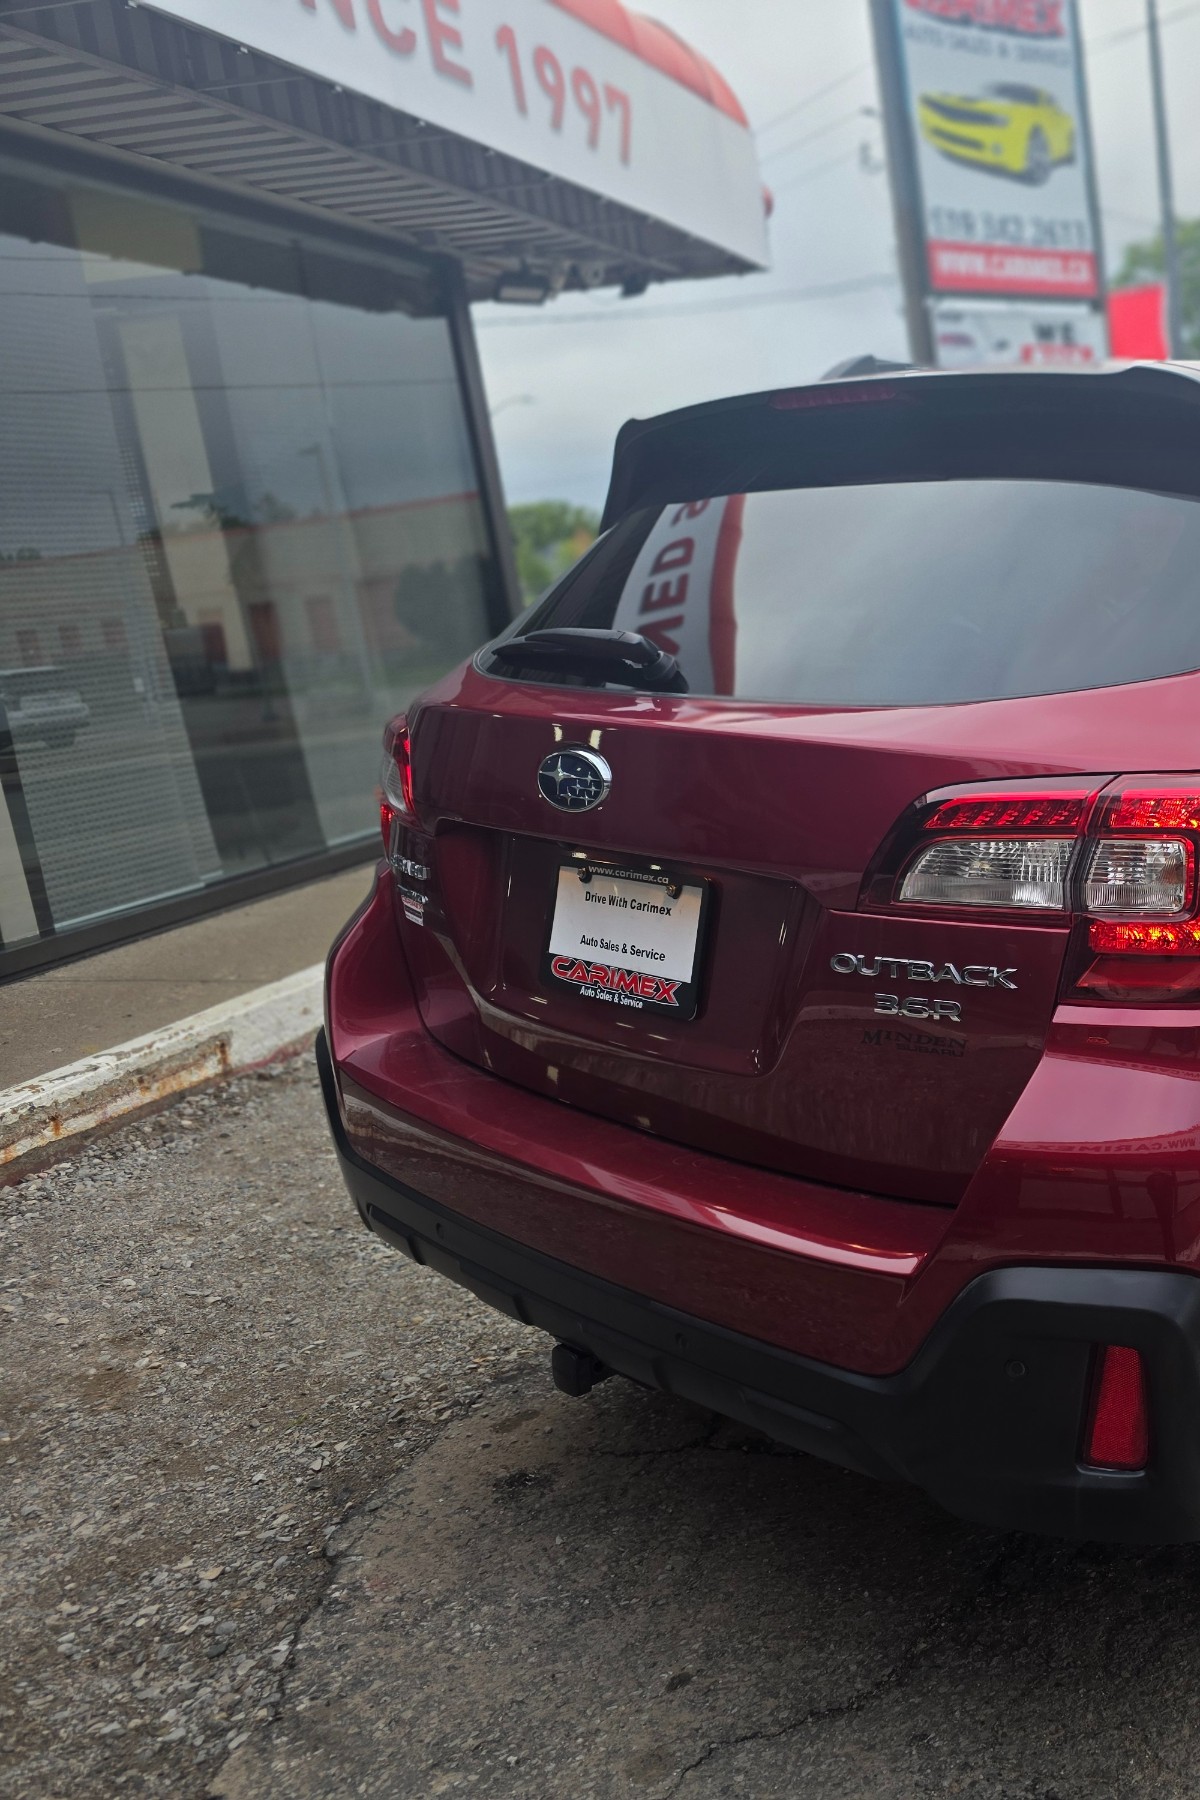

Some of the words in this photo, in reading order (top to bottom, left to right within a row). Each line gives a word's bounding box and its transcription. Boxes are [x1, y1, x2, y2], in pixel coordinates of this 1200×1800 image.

[496, 23, 631, 167] 1997
[588, 866, 669, 884] www.carimex.ca
[585, 891, 607, 905] Drive
[608, 894, 628, 909] With
[630, 899, 672, 916] Carimex
[580, 934, 598, 948] Auto
[599, 938, 619, 953] Sales
[621, 943, 628, 954] &
[629, 945, 665, 961] Service
[551, 956, 680, 1006] CARIMEX
[829, 952, 1018, 989] OUTBACK
[580, 986, 596, 998] Auto
[595, 988, 613, 1003] Sales
[613, 994, 619, 1003] &
[620, 995, 643, 1008] Service
[860, 1028, 969, 1050] MINDEN
[896, 1043, 965, 1057] SUBARU
